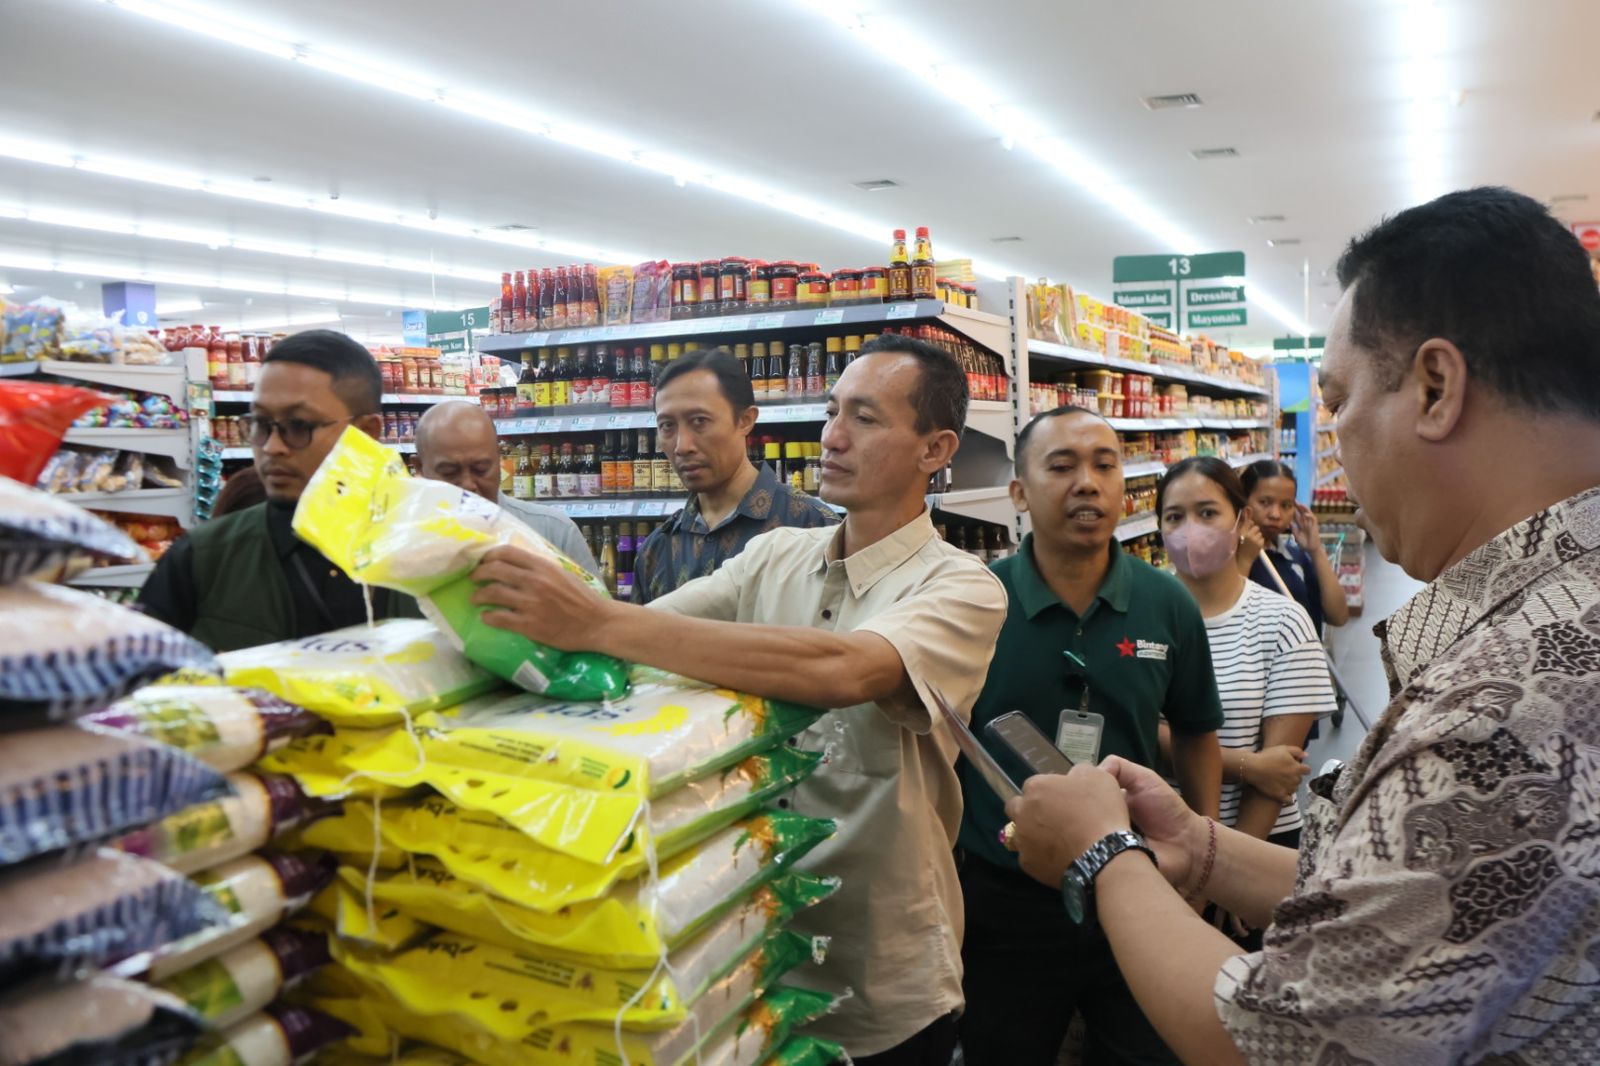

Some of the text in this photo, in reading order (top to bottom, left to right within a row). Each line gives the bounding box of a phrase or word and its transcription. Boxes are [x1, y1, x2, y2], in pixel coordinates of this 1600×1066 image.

[1168, 258, 1191, 275] 13
[1190, 289, 1238, 303] Dressing
[460, 312, 475, 326] 15
[1191, 311, 1241, 325] Mayonais
